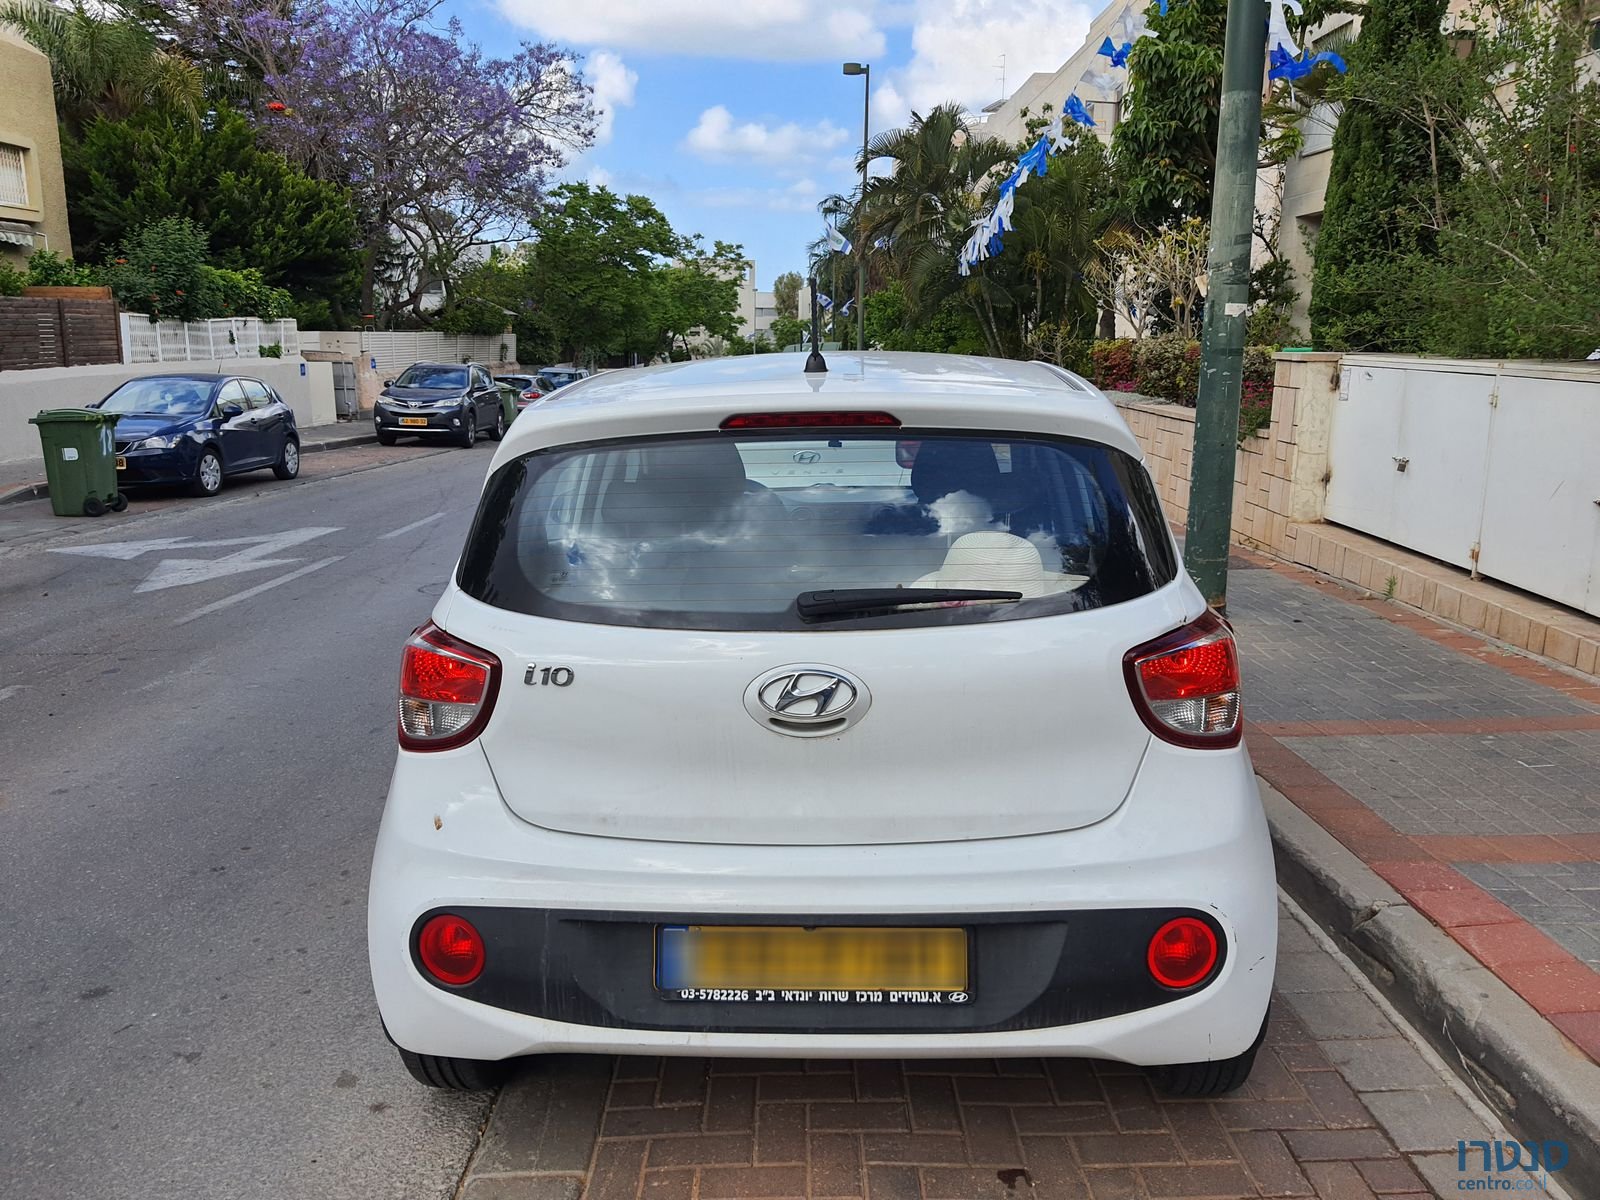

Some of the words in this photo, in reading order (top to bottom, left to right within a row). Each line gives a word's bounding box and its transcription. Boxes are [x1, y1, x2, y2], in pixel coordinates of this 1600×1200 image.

[524, 662, 575, 687] i10
[681, 988, 749, 1001] 03-5782226
[781, 990, 813, 1001] יונדאי
[818, 990, 849, 1002] שרות
[856, 991, 882, 1003] מרכז
